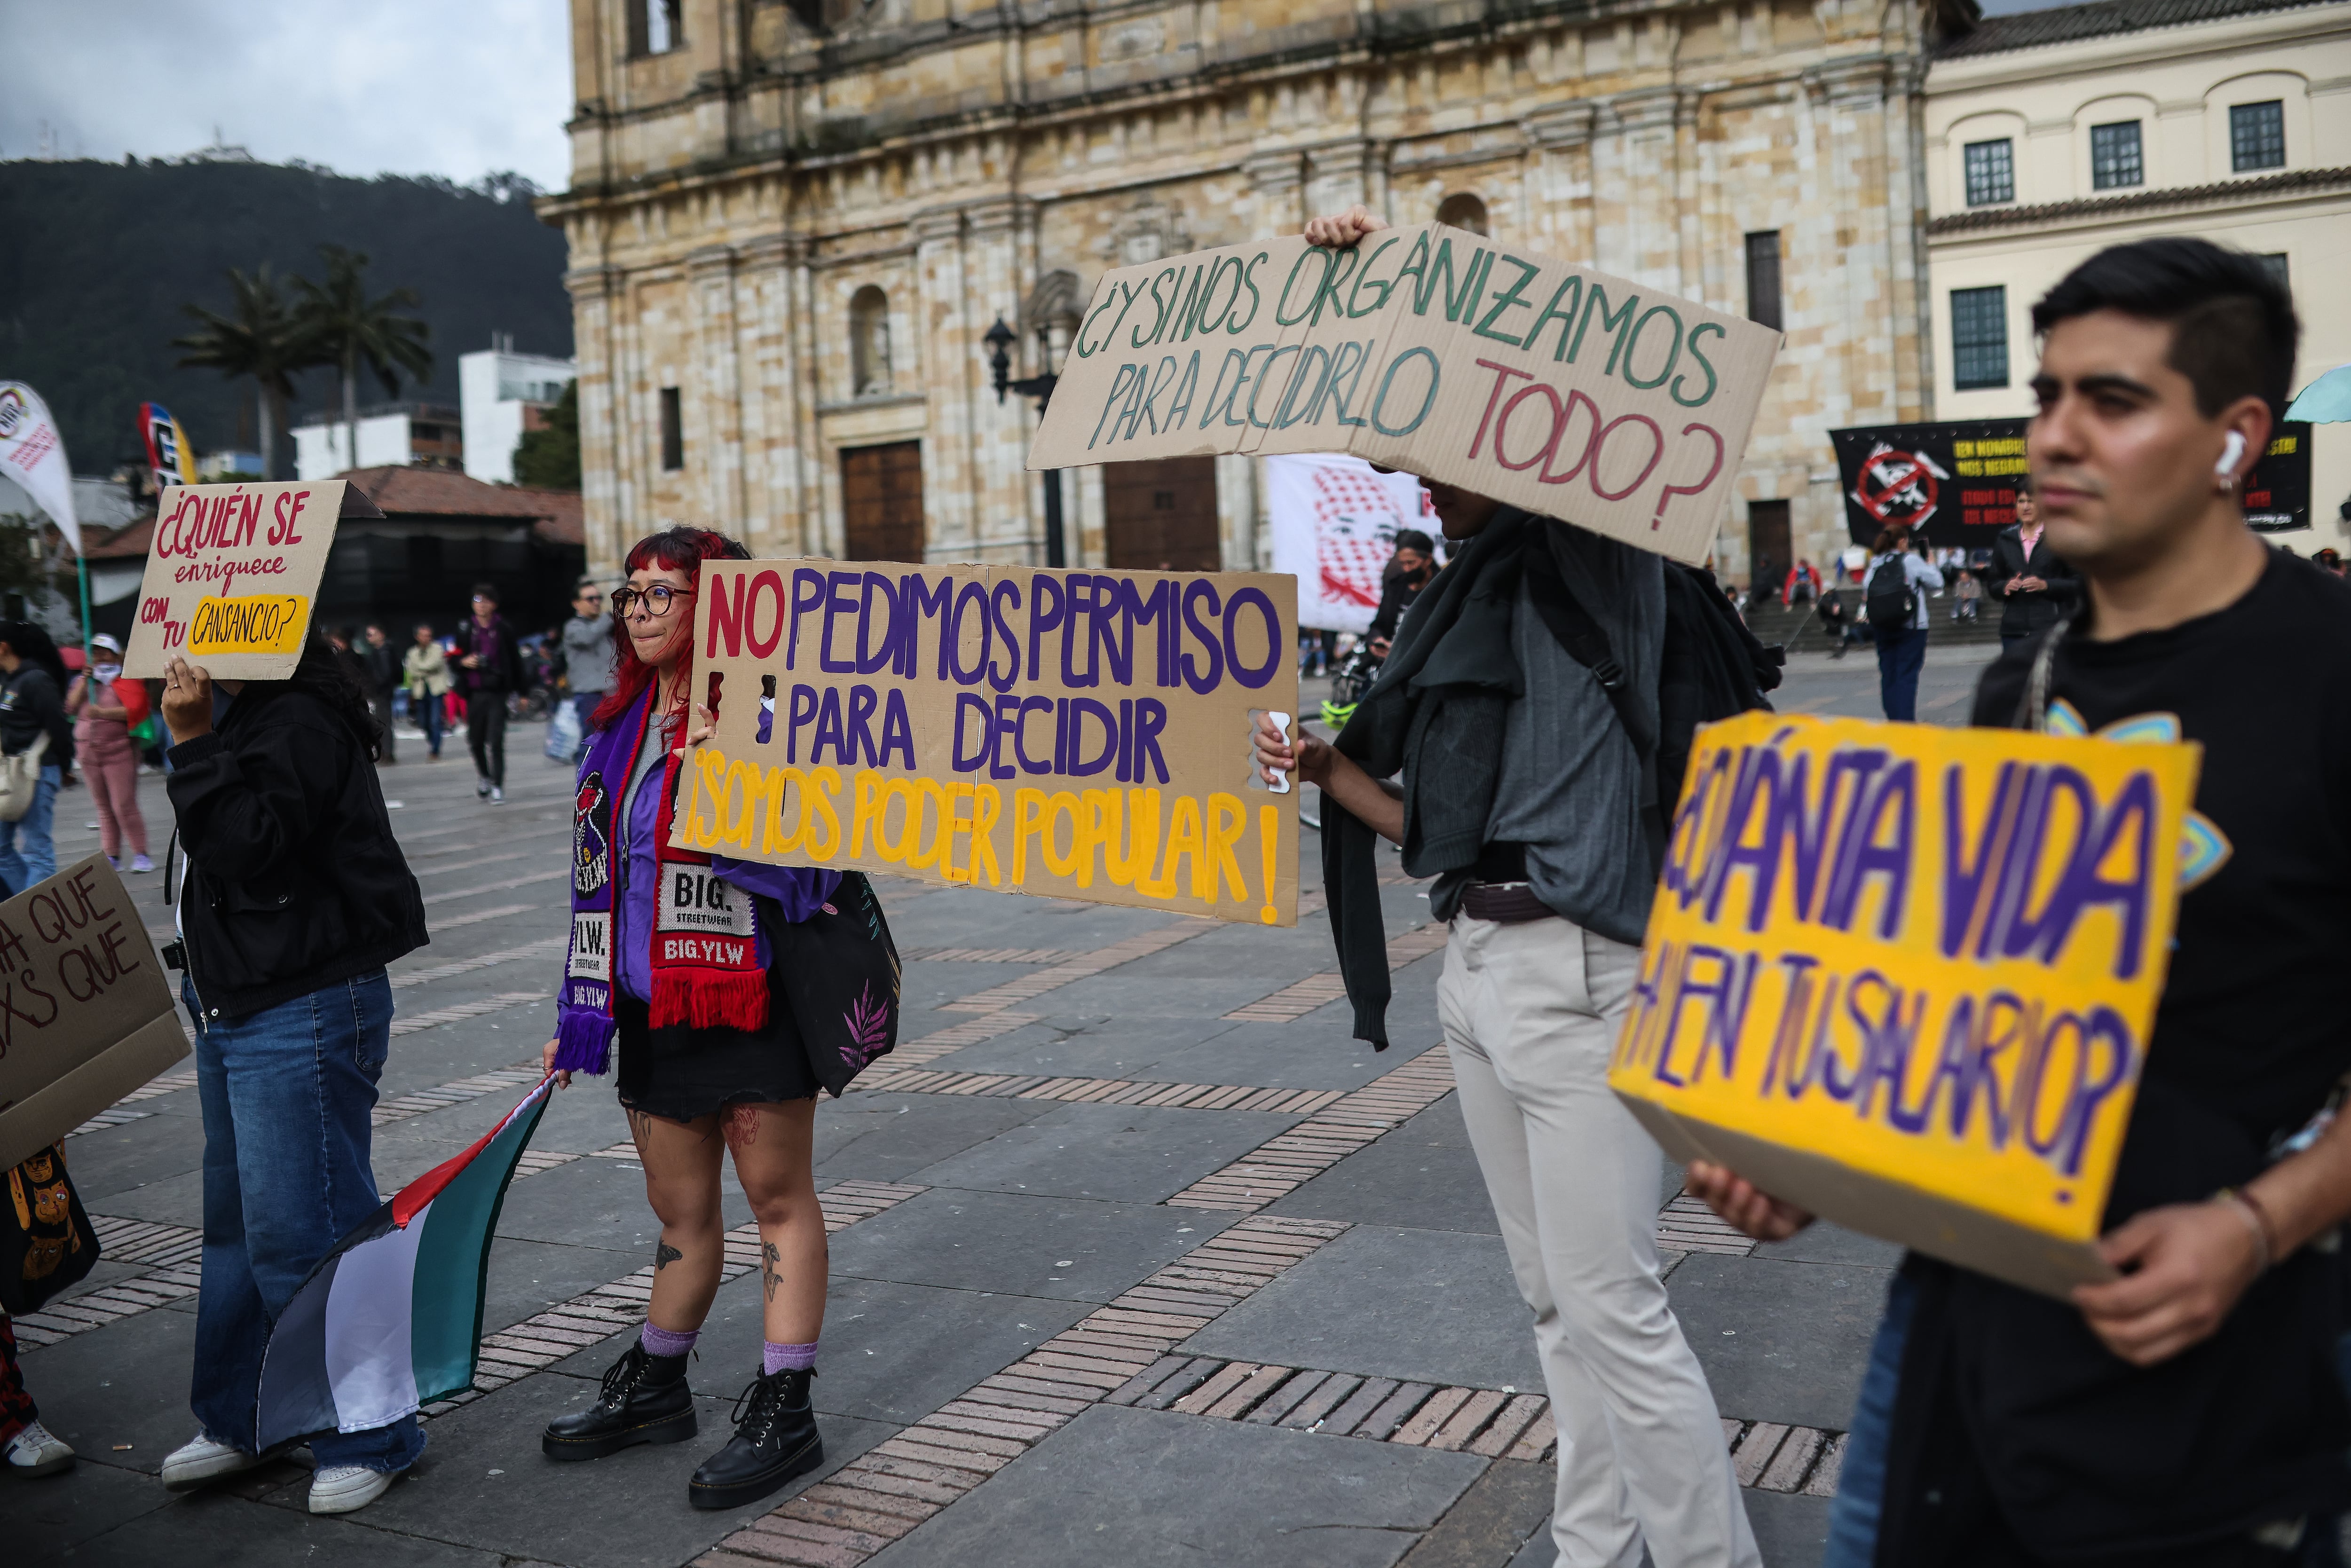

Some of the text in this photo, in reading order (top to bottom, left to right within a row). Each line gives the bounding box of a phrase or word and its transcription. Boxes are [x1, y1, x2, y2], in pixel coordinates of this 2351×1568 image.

[1276, 229, 1727, 408] ORGANIZAMOS
[1088, 339, 1725, 531] PARA DECIDIRLO TODO?
[157, 485, 311, 559] ¿QUIÉN SE
[174, 555, 287, 598] enriquece
[141, 596, 297, 650] CON TU CANSANCIO?
[706, 568, 1283, 695] NO PEDIMOS PERMISO
[787, 683, 1170, 785] PARA DECIDIR
[681, 747, 843, 862] ¡SOMOS
[850, 768, 1002, 887] PODER
[29, 865, 116, 944] QUE
[674, 872, 733, 913] BIG.
[1940, 759, 2159, 982] VIDA
[676, 913, 732, 926] STREETWEAR
[59, 921, 140, 1002] QUE
[575, 958, 600, 971] STREETWEAR
